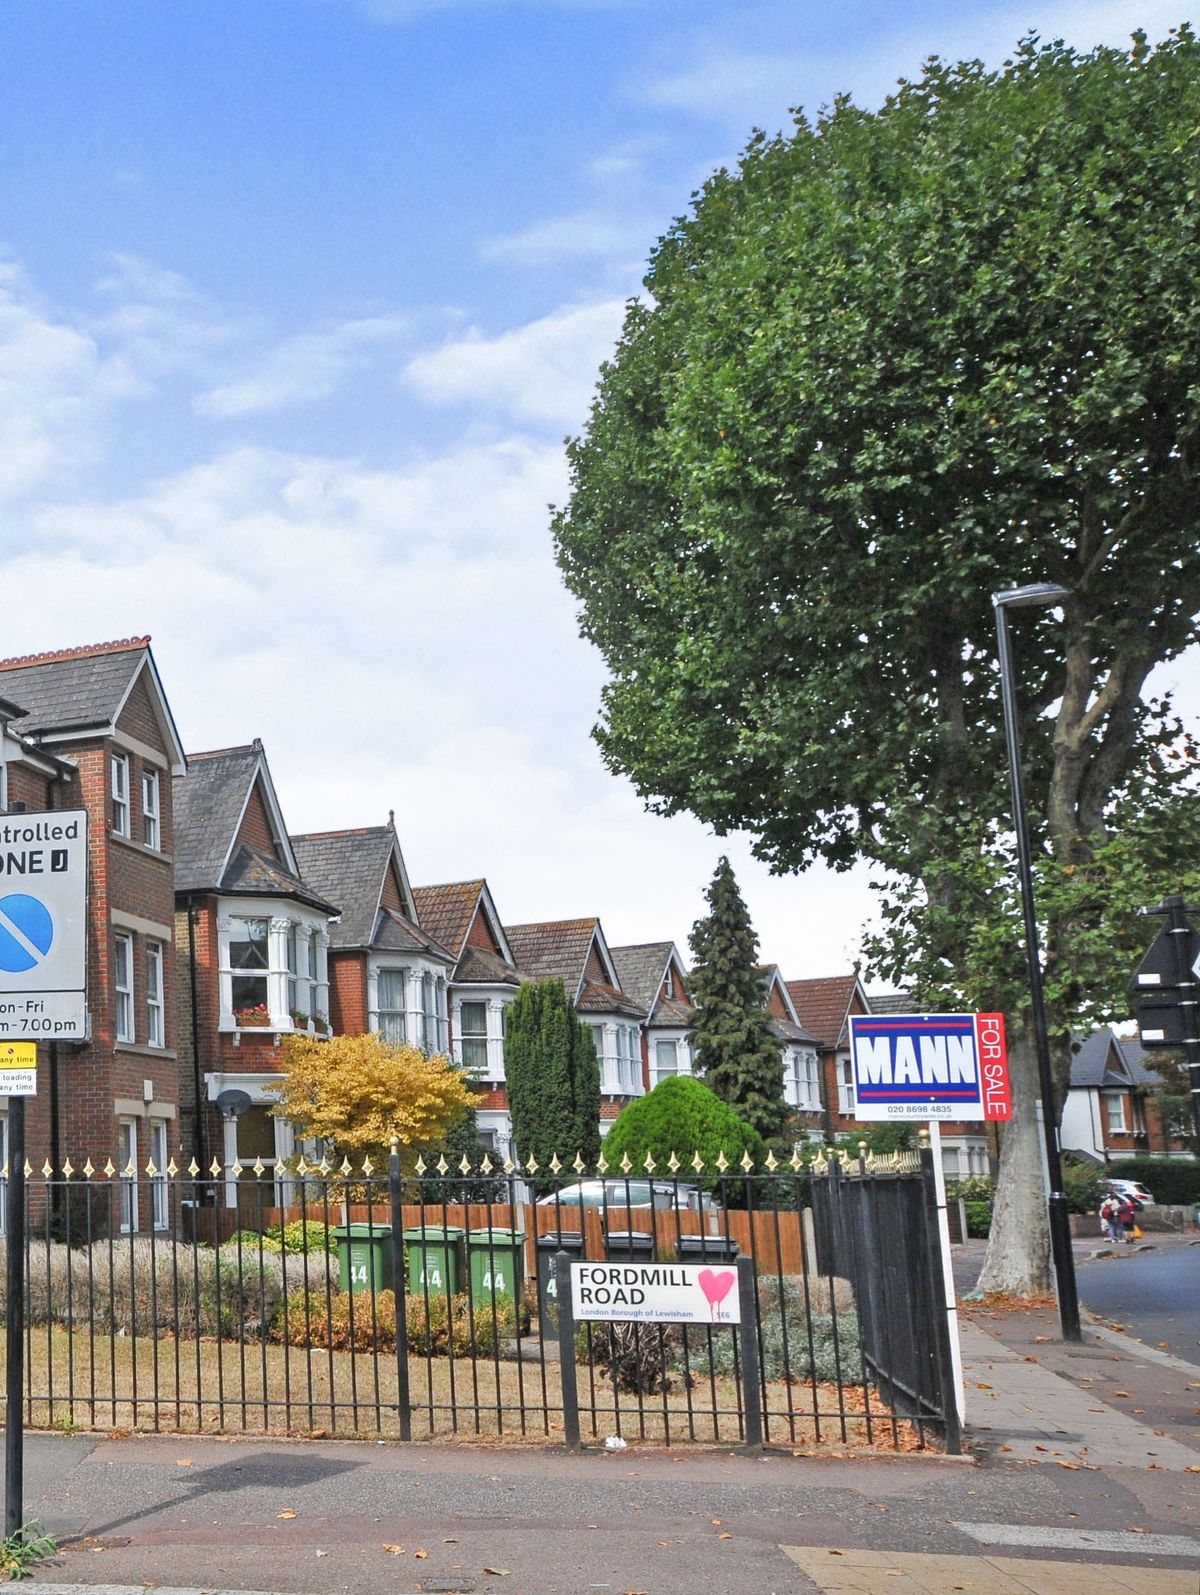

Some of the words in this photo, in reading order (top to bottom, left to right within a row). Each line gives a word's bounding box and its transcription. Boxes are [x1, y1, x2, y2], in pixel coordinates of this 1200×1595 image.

[980, 1019, 1002, 1059] FOR
[0, 1057, 14, 1065] any
[855, 1035, 977, 1085] MANN
[3, 1074, 32, 1082] loading
[0, 1085, 13, 1093] any
[984, 1064, 1006, 1115] SALE
[887, 1105, 904, 1113] 020
[482, 1271, 506, 1293] 44
[579, 1267, 693, 1287] FORDMILL
[580, 1287, 645, 1305] ROAD
[581, 1308, 609, 1316] London
[611, 1309, 643, 1318] Borough
[655, 1309, 694, 1318] Lewisham
[716, 1311, 730, 1319] SE6
